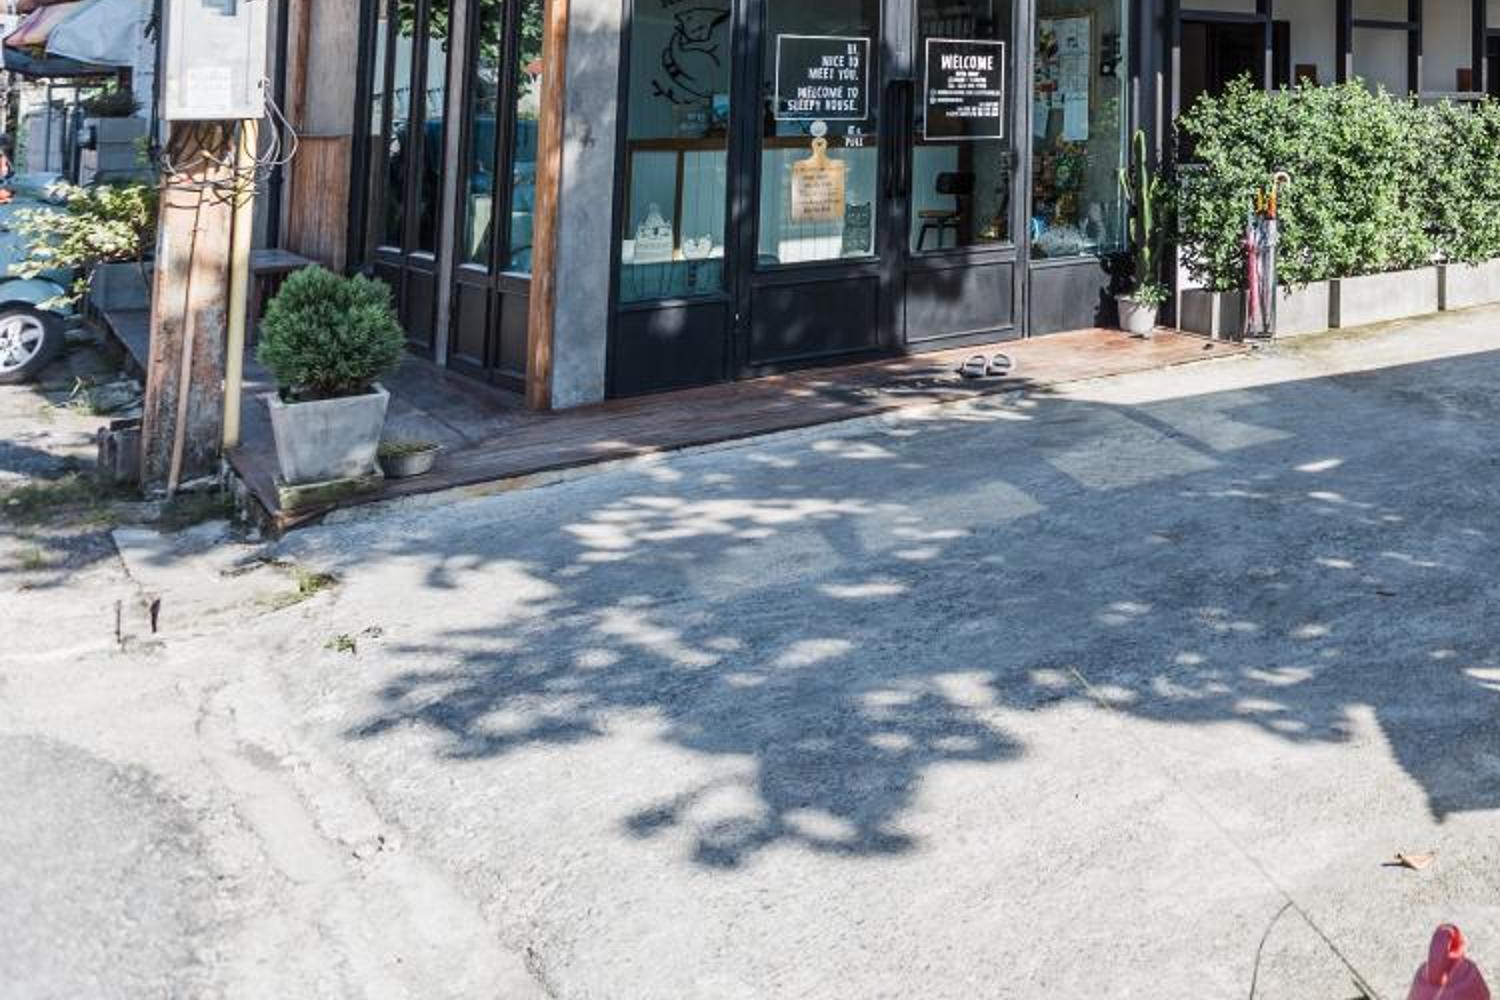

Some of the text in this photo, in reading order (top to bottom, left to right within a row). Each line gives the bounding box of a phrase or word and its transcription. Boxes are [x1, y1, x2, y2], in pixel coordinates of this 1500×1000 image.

[822, 55, 859, 68] NICE TO
[941, 53, 994, 70] WELCOME
[808, 68, 834, 80] MEET
[797, 86, 859, 99] WELCOME TO
[787, 99, 821, 111] SLEEPY
